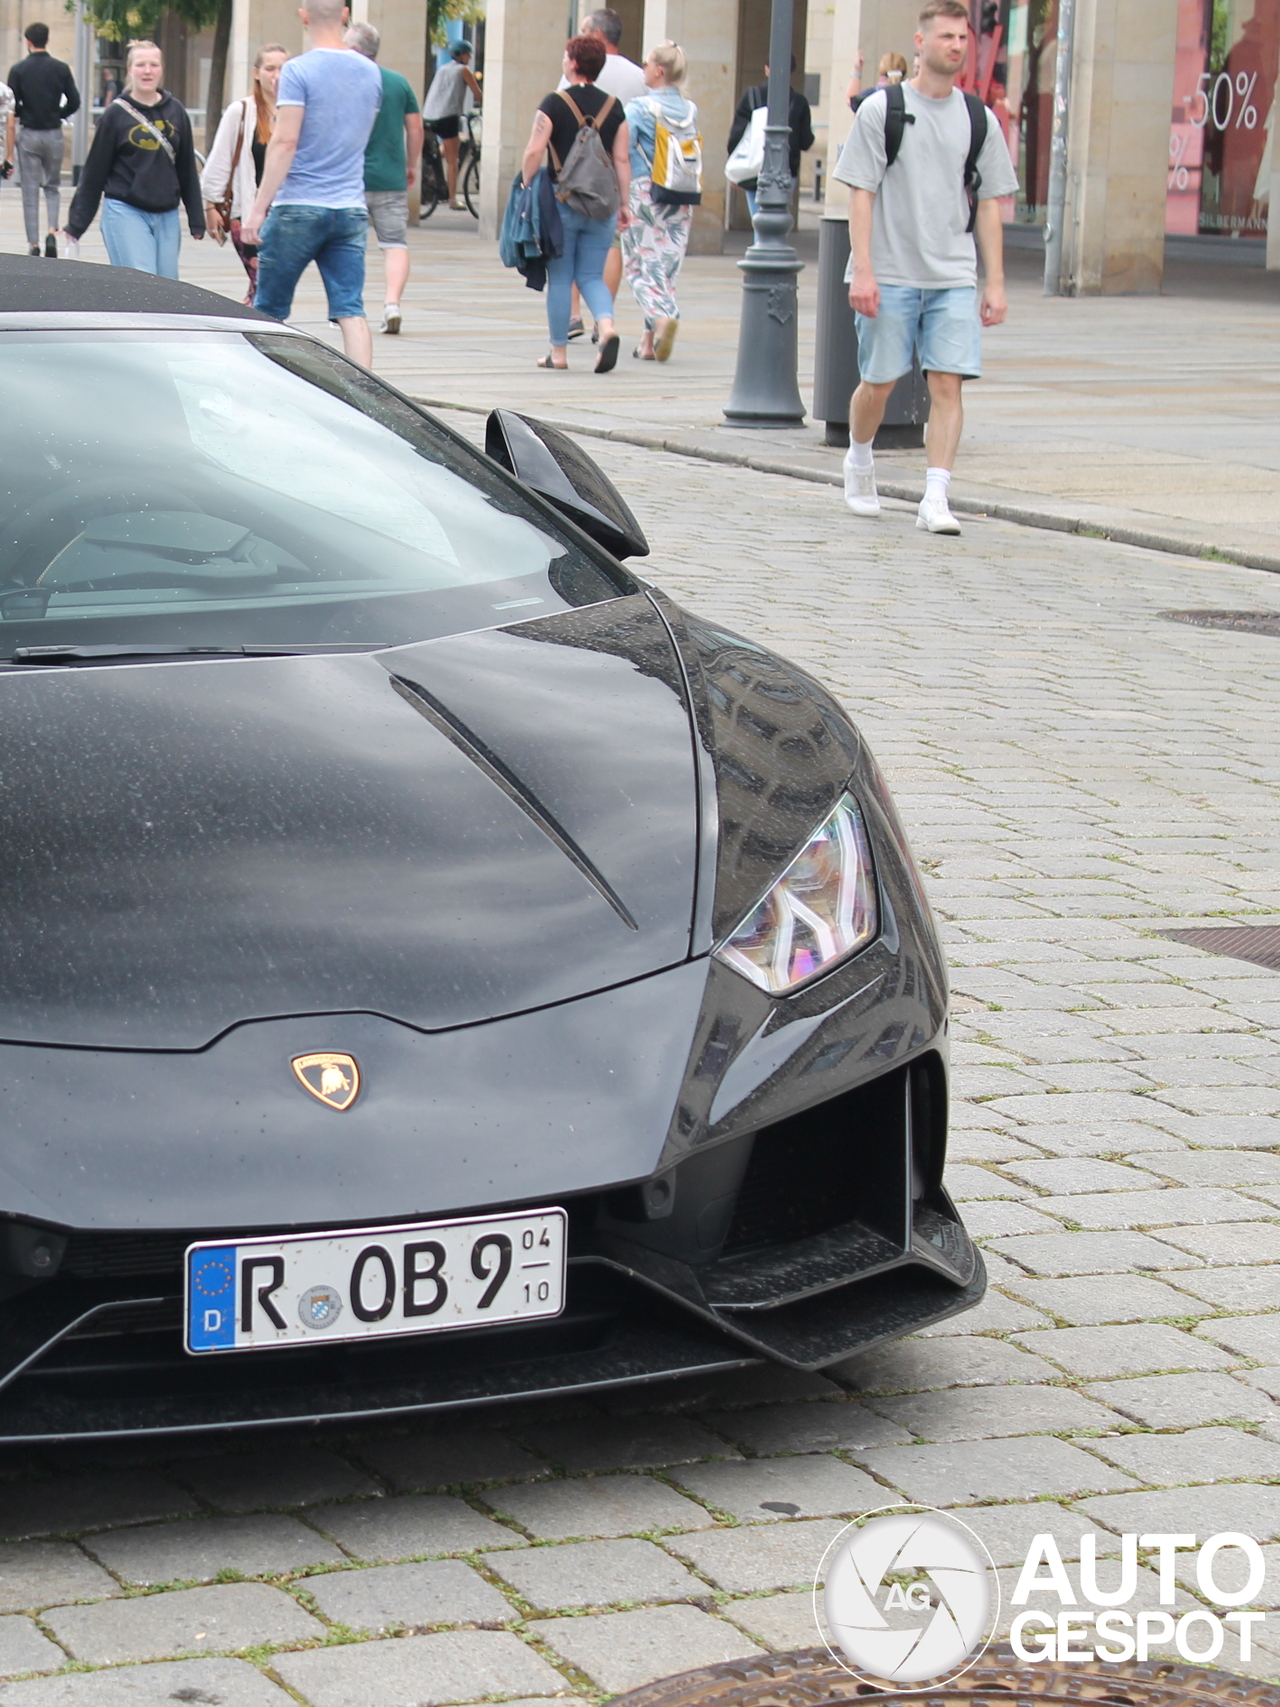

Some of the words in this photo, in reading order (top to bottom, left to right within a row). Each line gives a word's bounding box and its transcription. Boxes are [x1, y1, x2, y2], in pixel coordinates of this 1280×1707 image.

[1183, 71, 1258, 132] -50%
[1199, 212, 1269, 230] SILBERMANN
[522, 1228, 551, 1250] 04
[241, 1256, 287, 1332] R
[350, 1240, 449, 1322] OB
[470, 1233, 514, 1309] 9
[523, 1280, 549, 1303] 10
[204, 1309, 222, 1332] D
